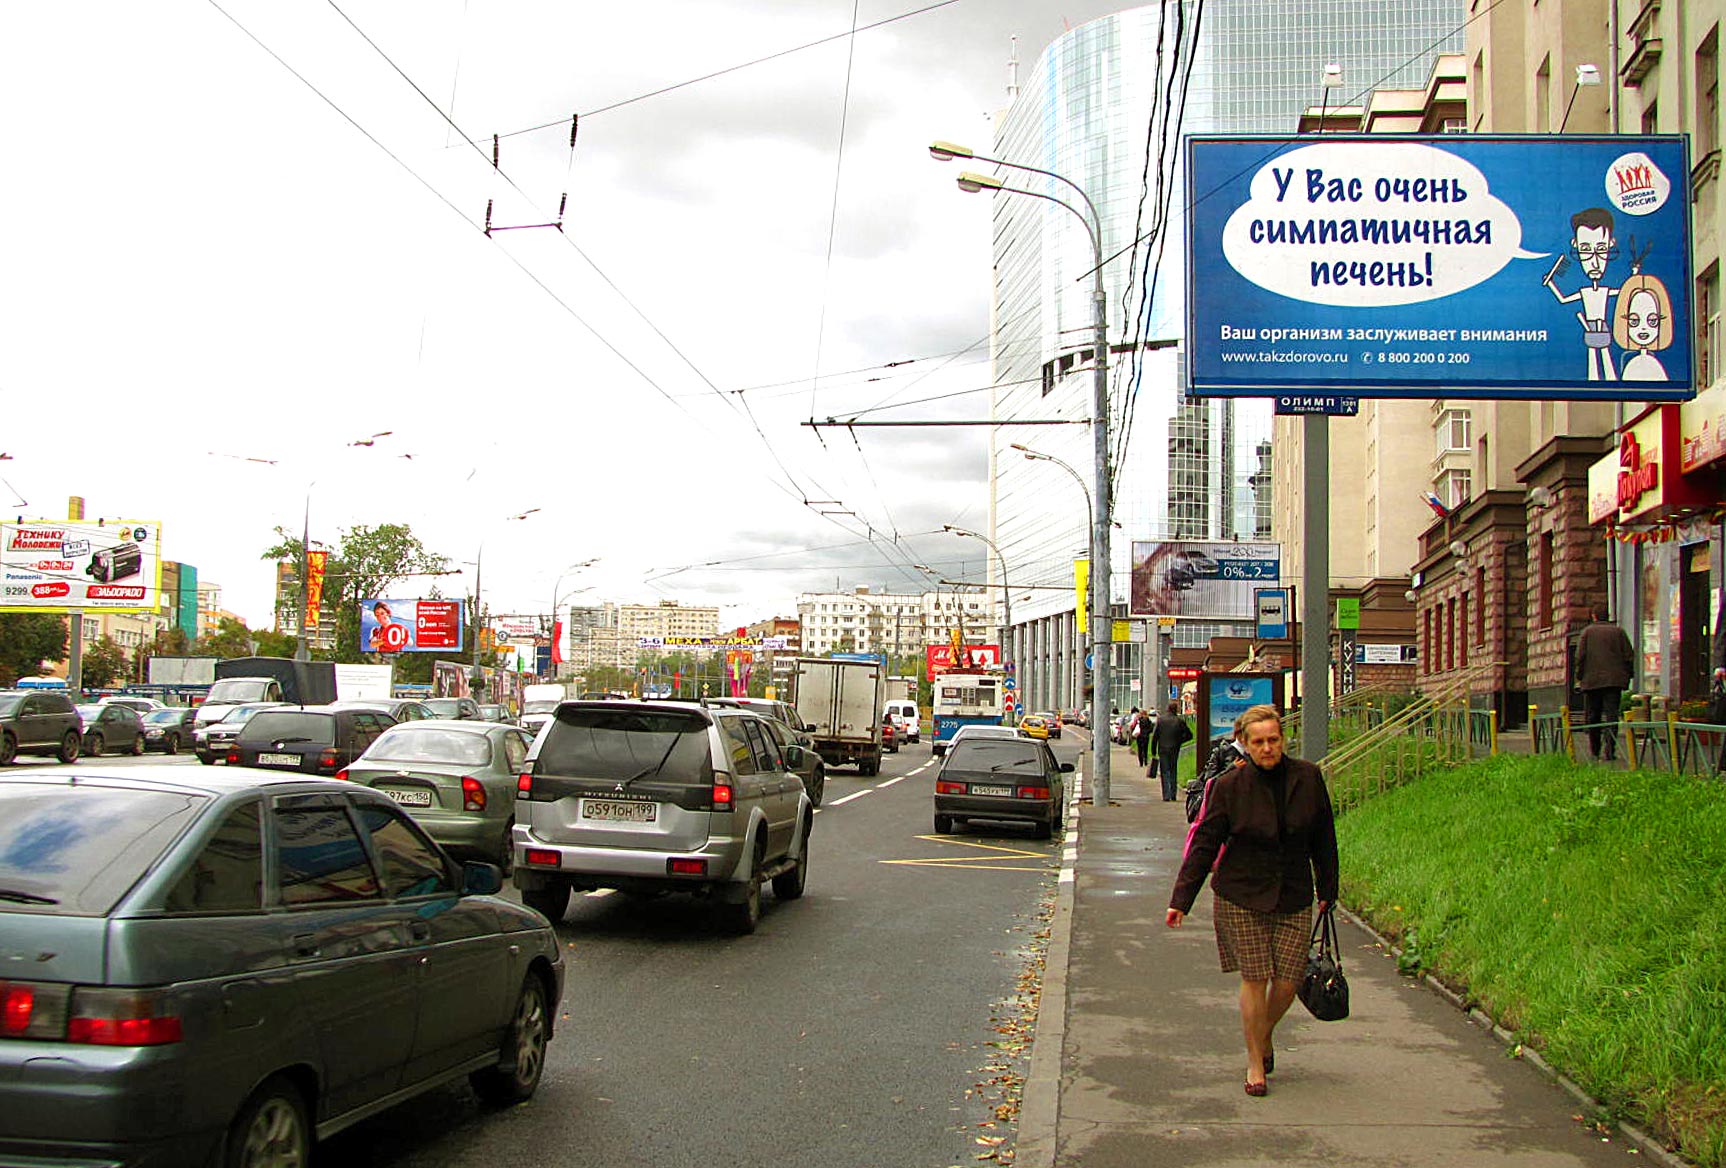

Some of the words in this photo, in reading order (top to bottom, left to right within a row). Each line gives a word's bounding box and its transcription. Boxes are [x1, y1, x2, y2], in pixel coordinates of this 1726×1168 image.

[1271, 167, 1294, 203] У
[1306, 168, 1363, 203] Вас
[1375, 177, 1468, 203] очень
[1621, 196, 1657, 208] РОССИЯ
[1249, 218, 1492, 245] симпатичная
[1310, 252, 1434, 287] печень!
[1220, 325, 1256, 340] Ваш
[1260, 328, 1343, 343] организм
[1346, 328, 1456, 344] заслуживает
[1460, 329, 1548, 342] внимания
[1221, 351, 1348, 363] www.takzdorovo.ru
[1377, 353, 1385, 363] 8
[1388, 353, 1411, 363] 800
[1413, 353, 1435, 363] 200
[1437, 353, 1445, 363] 0
[1448, 353, 1470, 364] 200
[1281, 397, 1335, 406] ОЛИМП
[1223, 566, 1245, 578] 0%
[1254, 566, 1262, 578] 2
[97, 586, 143, 597] ЭЛЬДОРАДО
[1343, 640, 1353, 694] КУХНИ
[384, 791, 412, 802] 97КС
[413, 793, 429, 801] 150
[586, 803, 633, 817] О591ОН
[635, 803, 652, 815] 199
